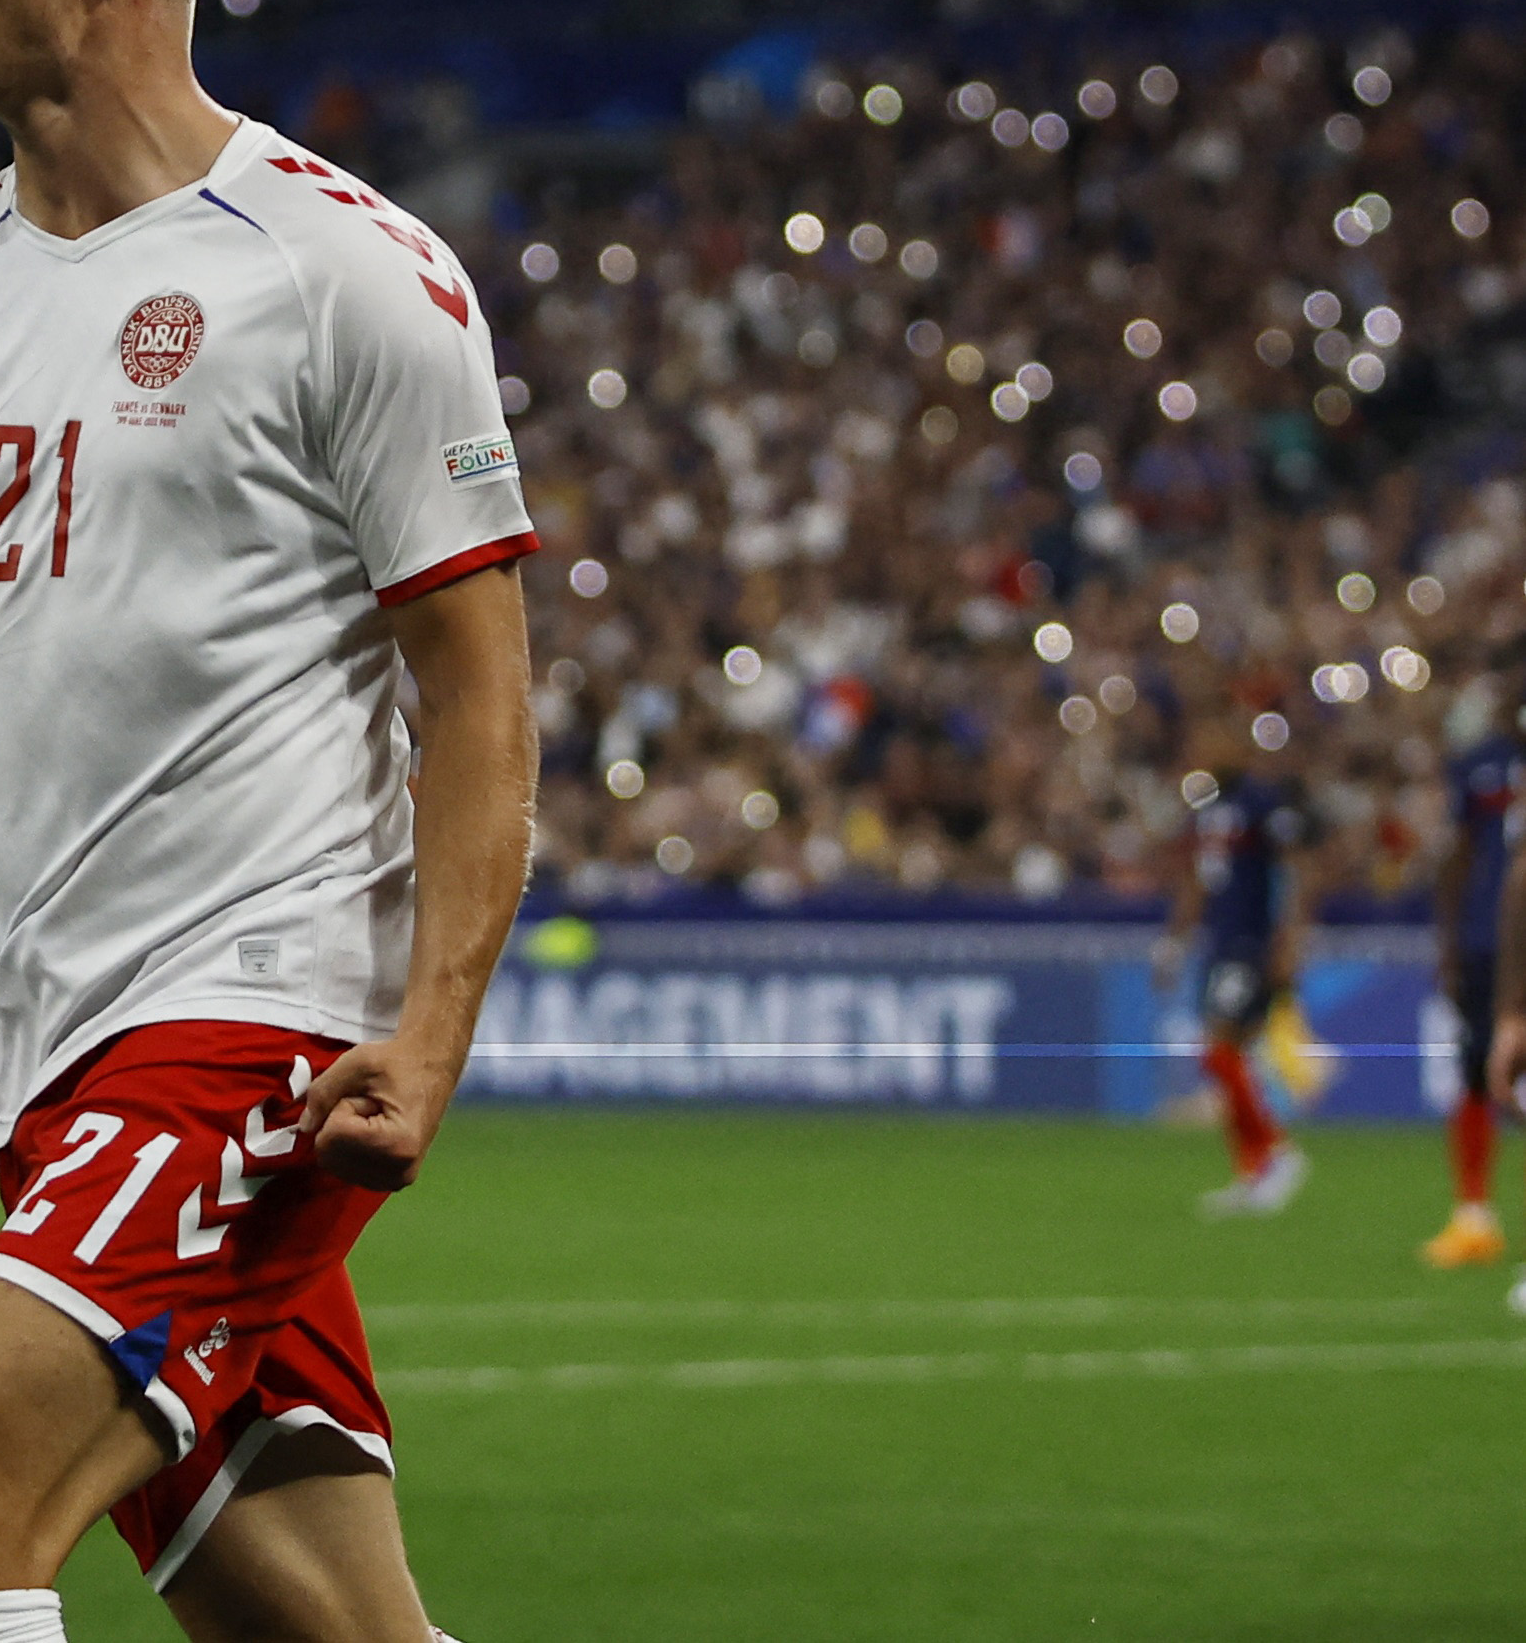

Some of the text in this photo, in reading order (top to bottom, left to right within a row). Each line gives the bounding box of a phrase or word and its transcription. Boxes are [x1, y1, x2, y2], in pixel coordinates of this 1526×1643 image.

[135, 323, 190, 354] DBU
[443, 442, 474, 458] UEFA
[1, 1111, 182, 1266] 21
